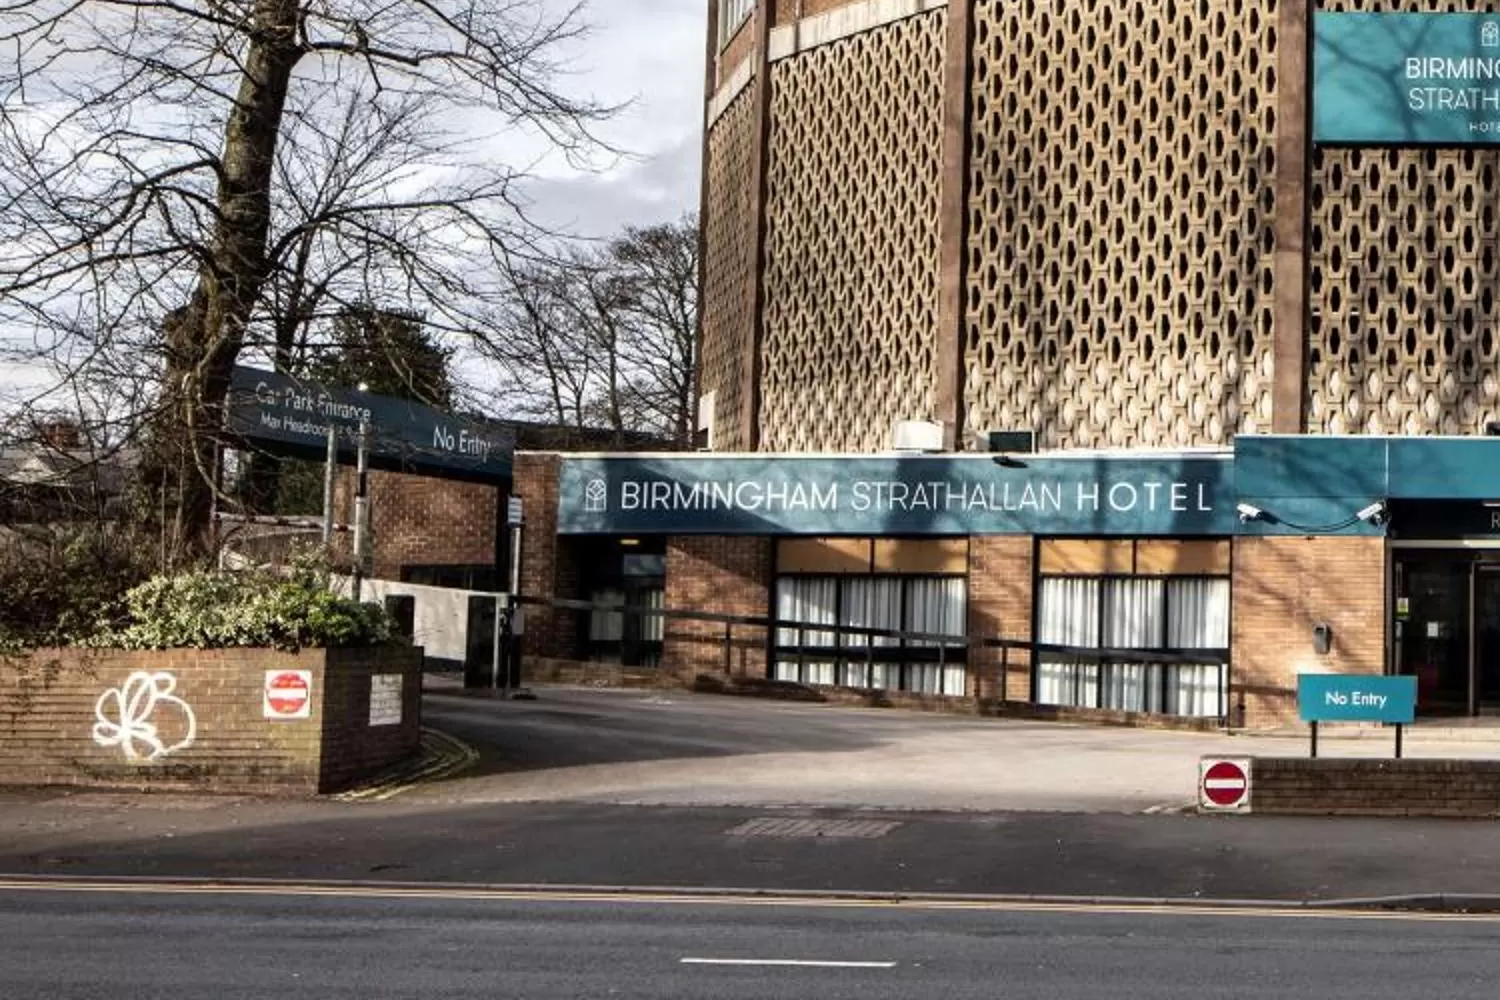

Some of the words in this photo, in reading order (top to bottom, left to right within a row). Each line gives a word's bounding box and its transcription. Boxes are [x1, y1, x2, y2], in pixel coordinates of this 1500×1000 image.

[284, 386, 314, 412] Park
[432, 425, 455, 451] No
[459, 429, 492, 463] Entry
[620, 481, 838, 510] BIRMINGHAM
[850, 481, 1062, 511] STRATHALLAN
[1076, 482, 1213, 511] HOTEL
[1324, 690, 1348, 705] No
[1351, 691, 1388, 710] Entry
